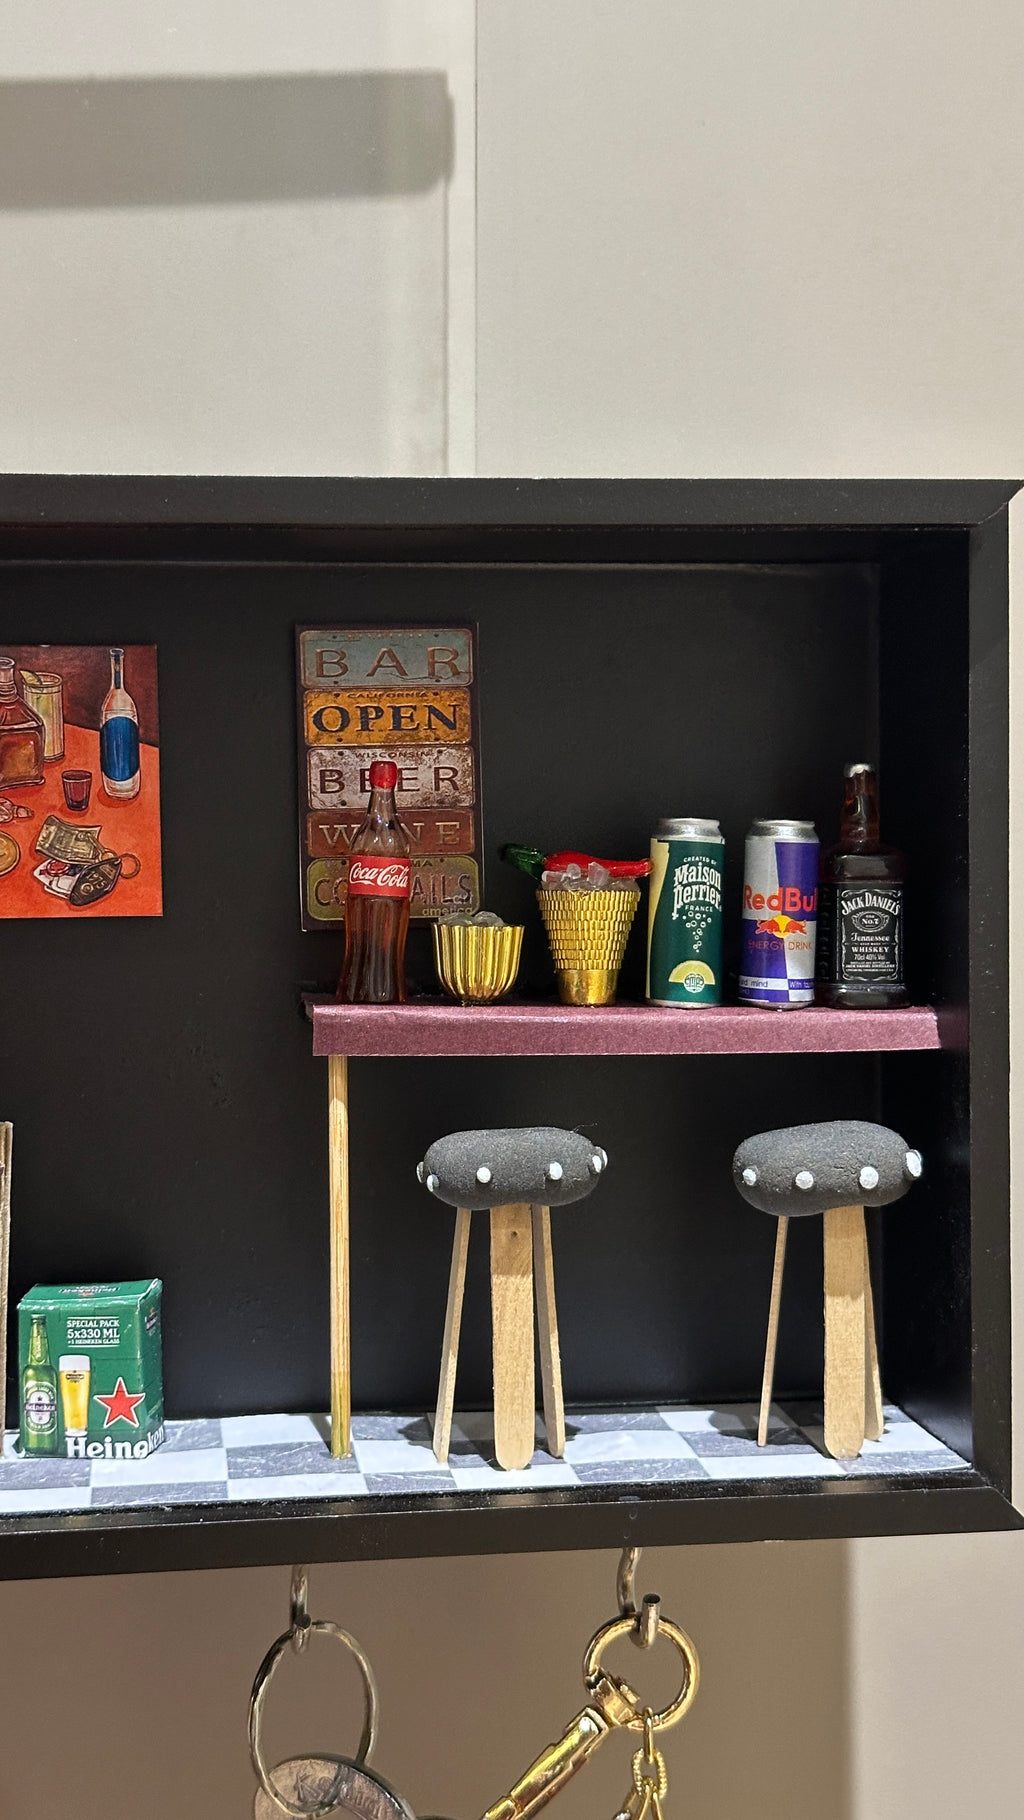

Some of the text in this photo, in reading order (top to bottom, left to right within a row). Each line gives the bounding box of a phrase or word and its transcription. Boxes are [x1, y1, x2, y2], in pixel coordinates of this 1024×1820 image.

[315, 646, 461, 678] BAR
[312, 703, 461, 733] OPEN
[354, 751, 430, 759] WISCONSIN
[318, 822, 460, 848] WNE
[674, 862, 721, 890] Maison
[685, 904, 713, 913] FRANCE
[841, 896, 864, 915] JACK
[748, 940, 784, 950] ENERGY
[66, 1319, 120, 1328] SPECIAL PACK
[67, 1328, 120, 1339] 5x330 ML
